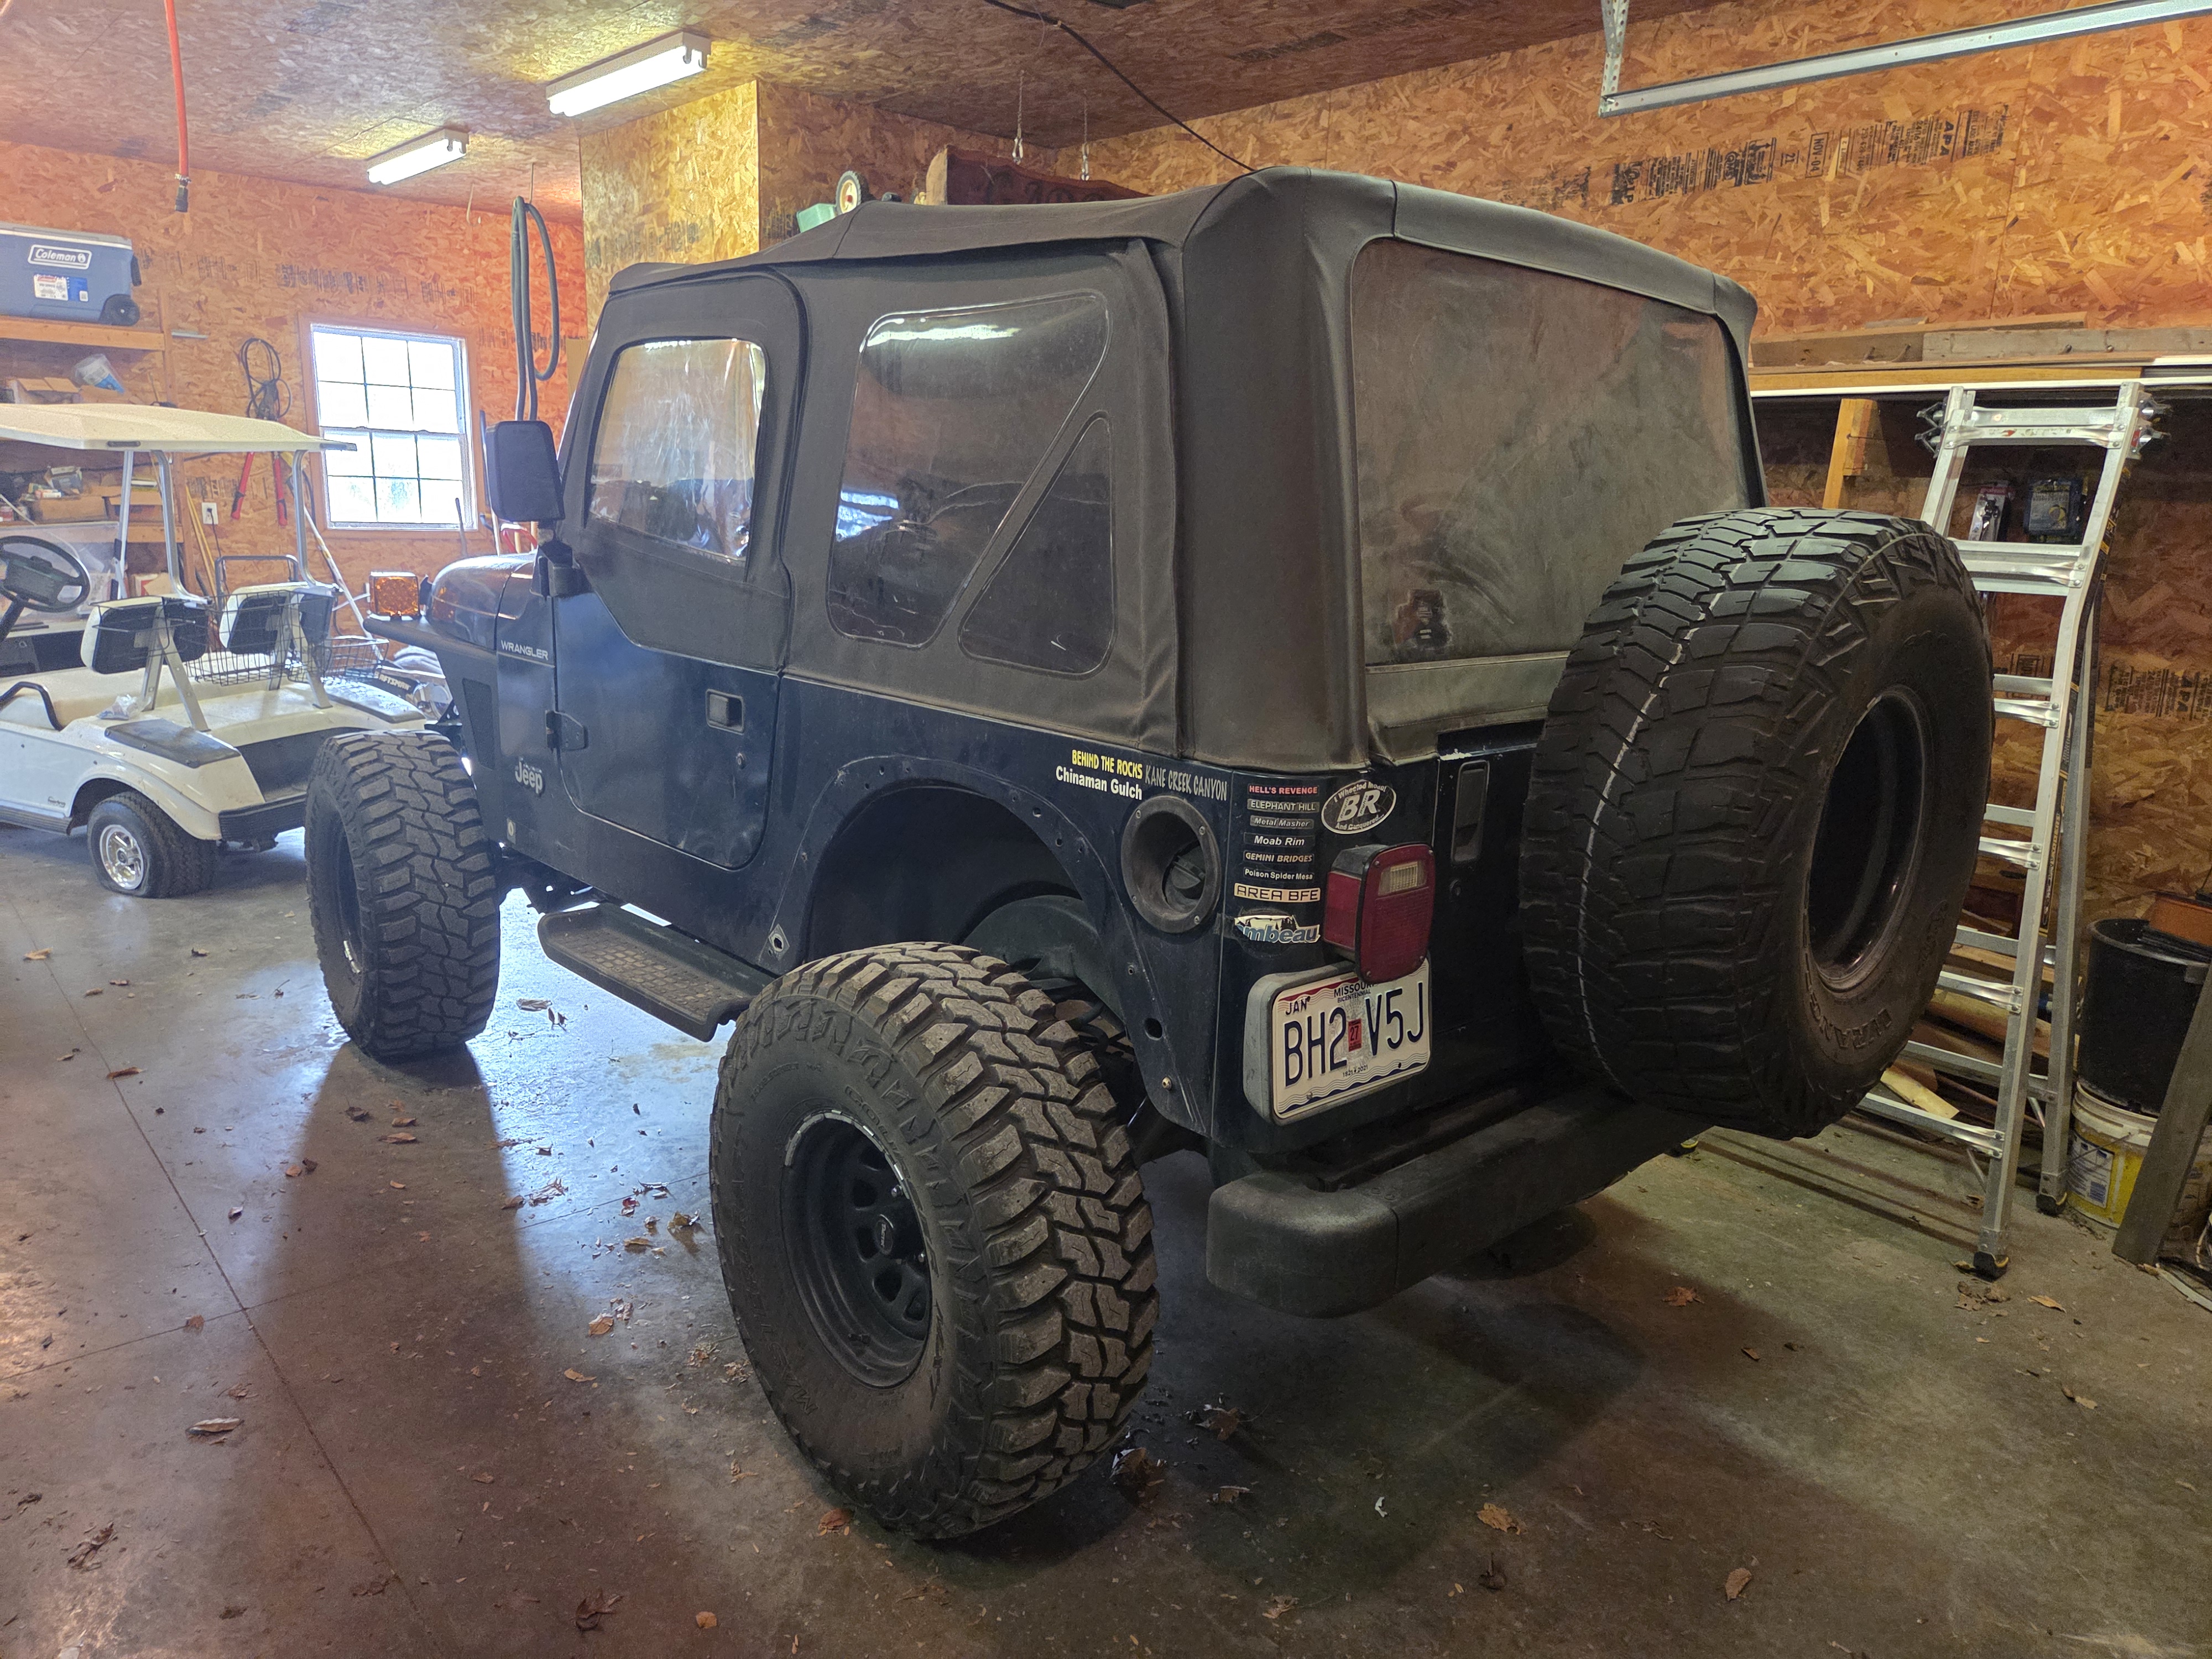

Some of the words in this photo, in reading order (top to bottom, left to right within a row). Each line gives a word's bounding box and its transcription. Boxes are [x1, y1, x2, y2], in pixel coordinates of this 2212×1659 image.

[1940, 120, 1954, 156] APA
[1811, 138, 1824, 173] NOV-04
[35, 248, 76, 262] Coleman
[500, 639, 549, 661] WRANGLER
[1072, 749, 1099, 769] BEHIND
[1101, 755, 1115, 773] THE
[1117, 759, 1143, 780] ROCKS
[514, 760, 544, 794] Jeep
[1056, 765, 1107, 792] Chinaman
[1110, 778, 1142, 801] Gulch
[1145, 765, 1166, 788] KANE
[1168, 770, 1192, 795] CREEK
[1193, 775, 1227, 801] CANYON
[1249, 785, 1276, 794] HELL'S
[1250, 801, 1297, 811] ELEPHANT
[1298, 803, 1316, 811] HILL
[1337, 789, 1381, 823] BR
[1279, 819, 1310, 827] Masher
[1335, 822, 1348, 831] And
[1254, 835, 1282, 846] Moab
[1285, 837, 1305, 846] Rim
[1245, 852, 1275, 862] GEMINI
[1277, 854, 1313, 863] BRIDGES
[1245, 868, 1269, 878] Poison
[1270, 871, 1295, 881] Spider
[1237, 886, 1282, 901] AREA
[1288, 889, 1318, 901] BFE
[1333, 982, 1379, 998] MISSOUR
[1337, 988, 1371, 1004] BICENTENNIAL
[1285, 999, 1308, 1016] JAN
[1284, 1006, 1348, 1087] BH2
[1365, 982, 1425, 1056] V5J
[1349, 1025, 1359, 1042] 27
